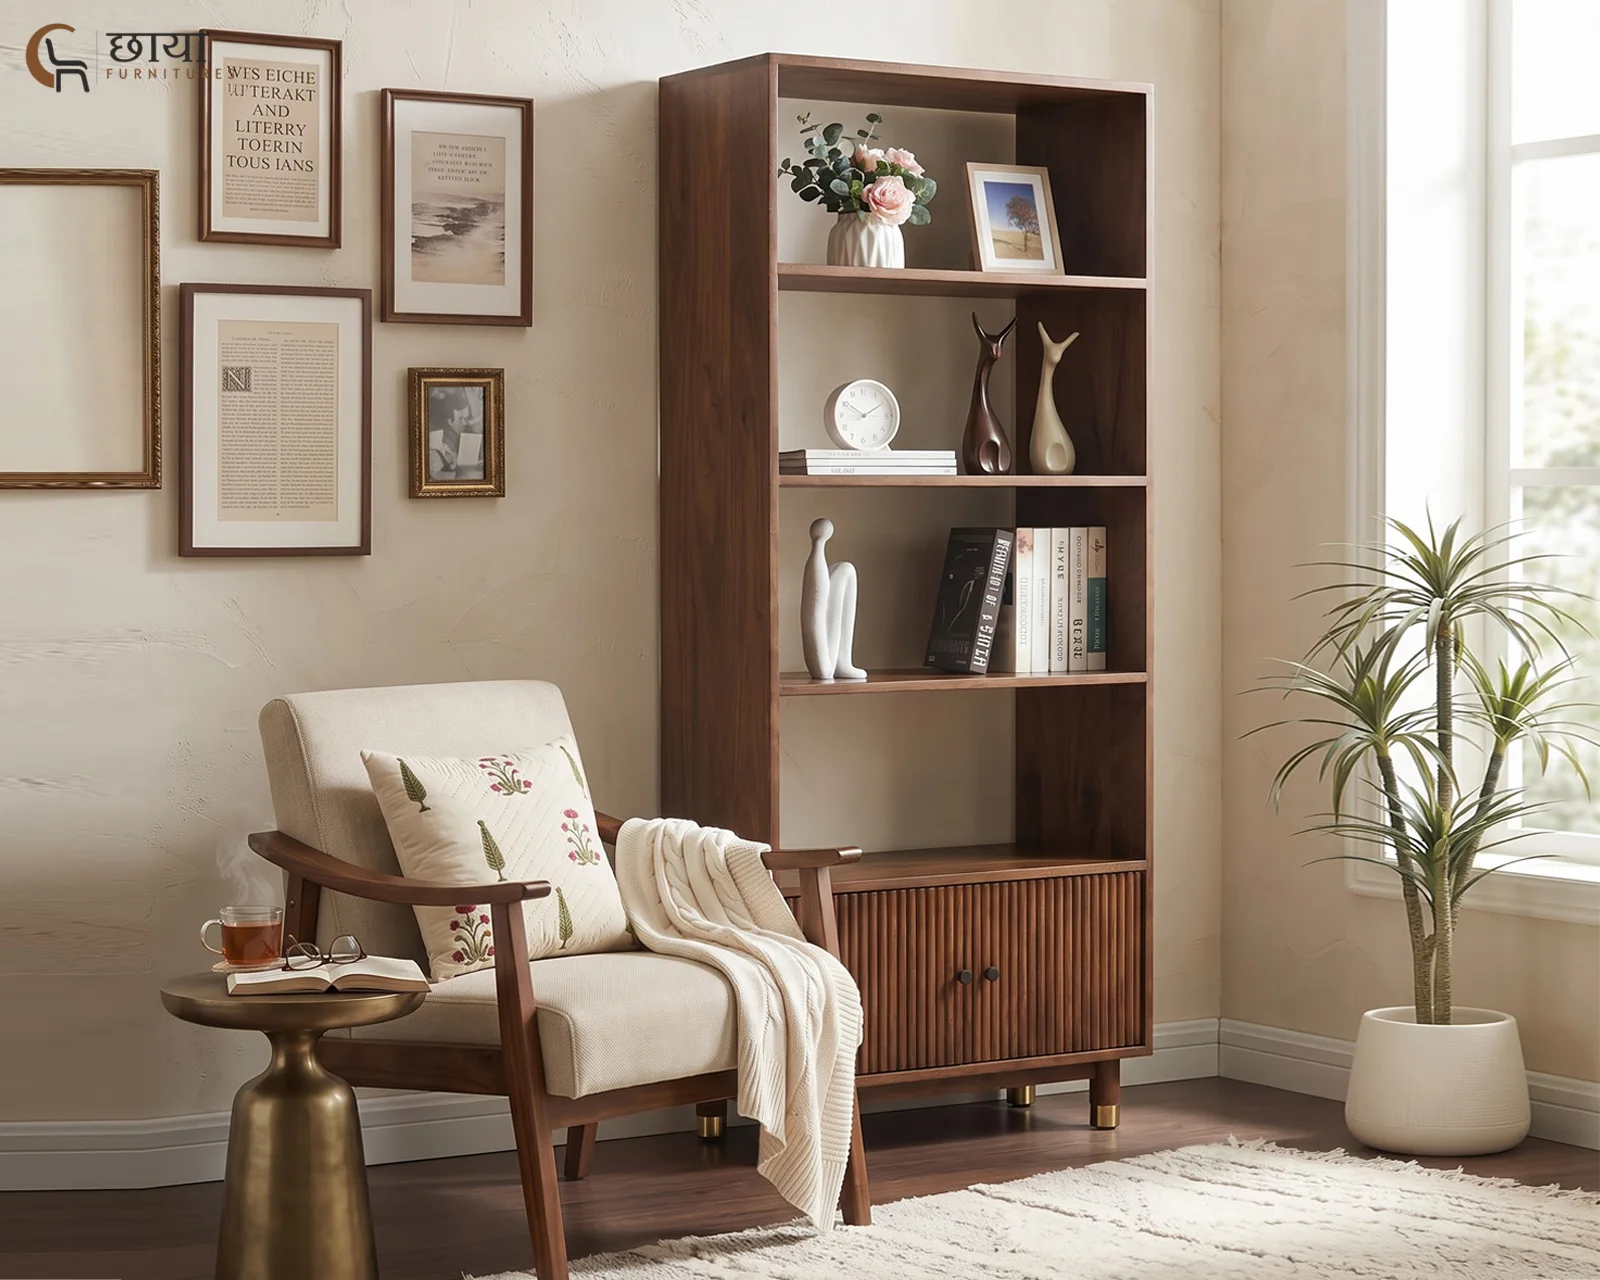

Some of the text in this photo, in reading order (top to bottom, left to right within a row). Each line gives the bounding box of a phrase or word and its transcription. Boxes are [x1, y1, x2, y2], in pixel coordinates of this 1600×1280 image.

[266, 68, 316, 85] EICHE
[252, 103, 290, 118] AND
[235, 119, 307, 137] LITERRY
[237, 138, 303, 154] TOERIN
[226, 154, 270, 170] TOUS
